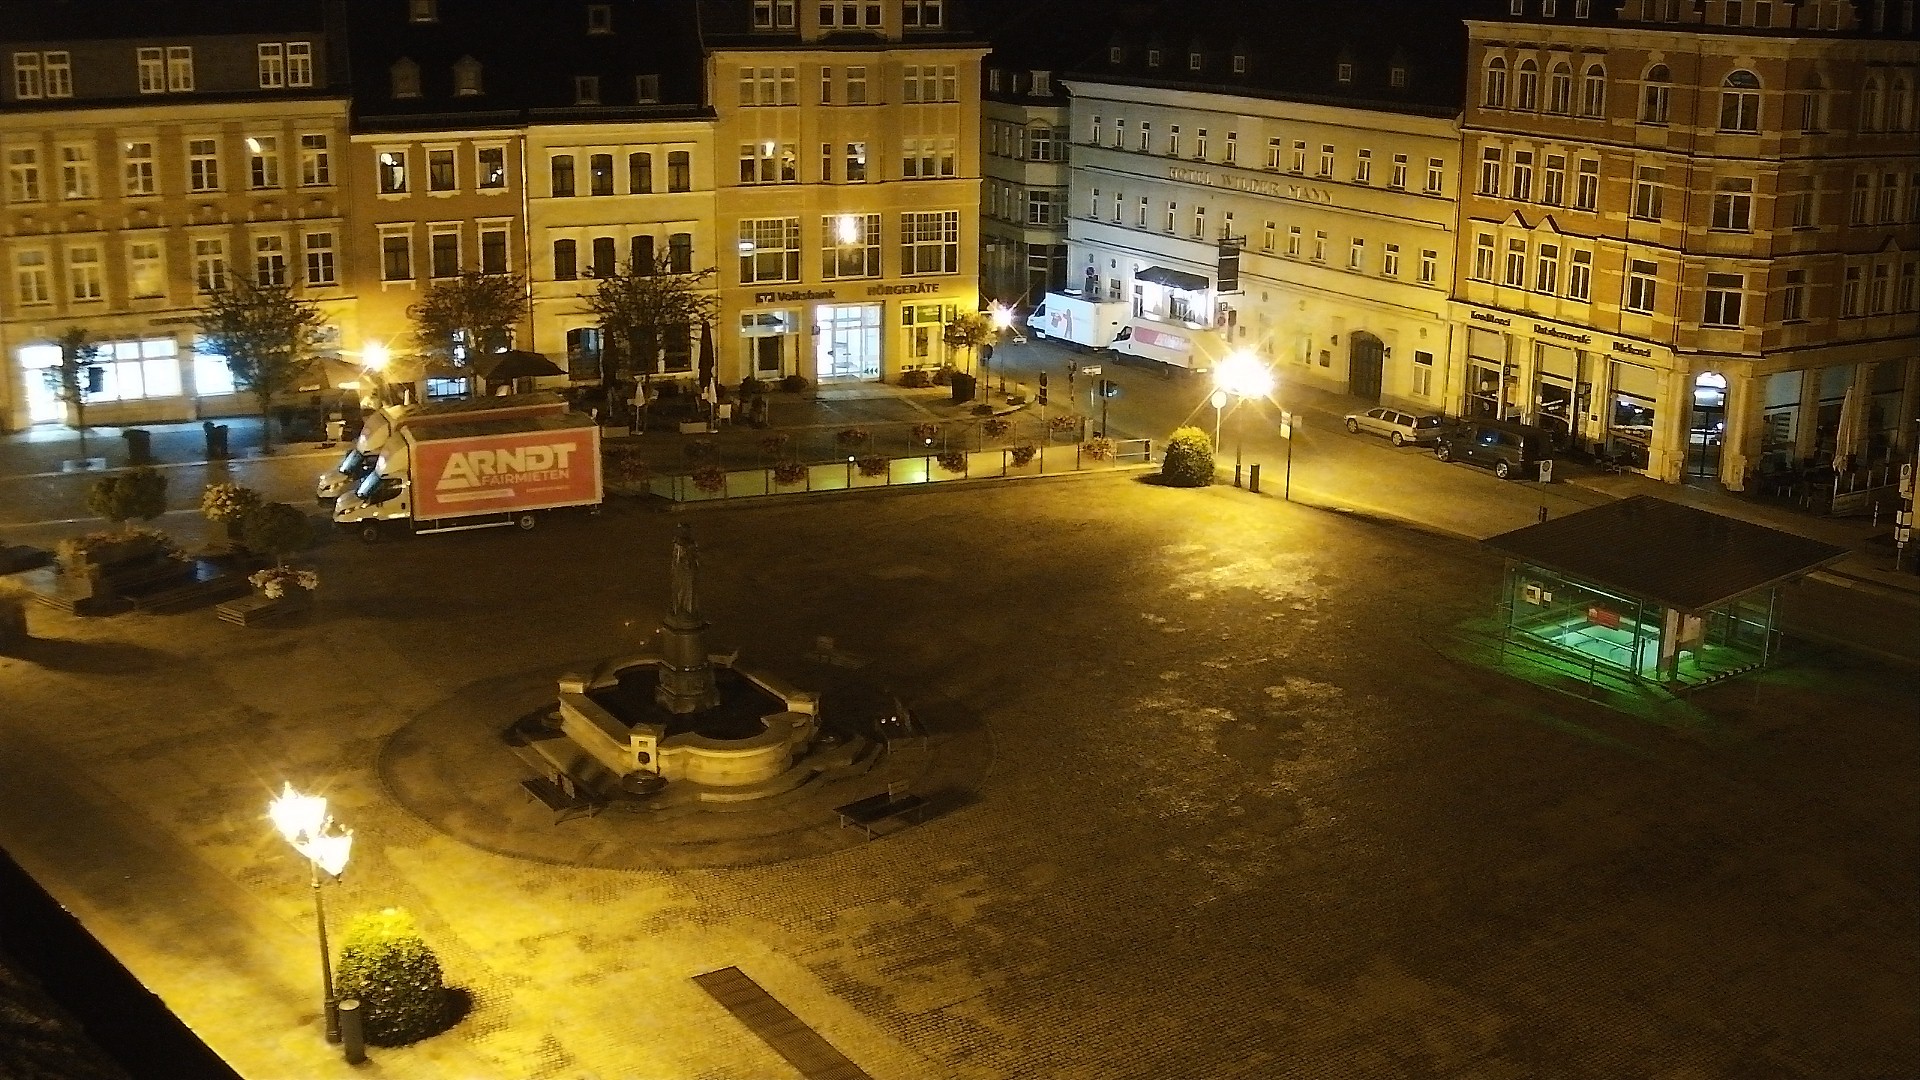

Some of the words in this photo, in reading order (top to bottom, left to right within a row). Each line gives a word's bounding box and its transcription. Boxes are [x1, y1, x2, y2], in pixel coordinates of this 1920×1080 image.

[1169, 167, 1213, 185] HOTEL
[1221, 174, 1280, 196] WILDER
[1288, 185, 1333, 205] MANN
[778, 288, 836, 302] Volksbank
[867, 282, 940, 296] HÖRGERÄTE
[435, 442, 577, 491] ARNDT
[481, 468, 569, 487] FAIRMIETEN
